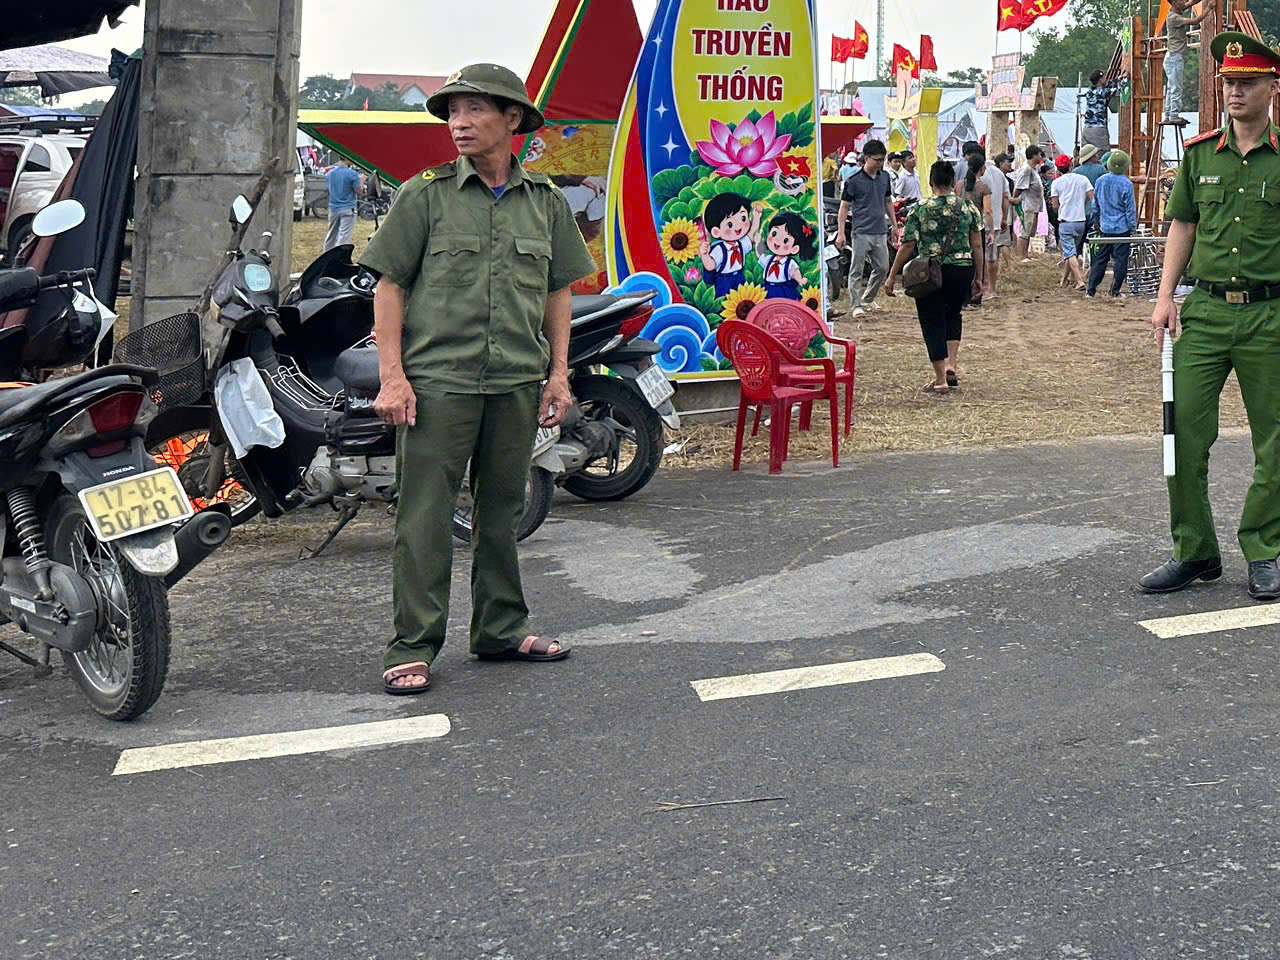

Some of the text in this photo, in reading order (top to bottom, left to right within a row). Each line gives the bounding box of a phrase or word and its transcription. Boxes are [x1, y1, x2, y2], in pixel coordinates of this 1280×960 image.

[692, 23, 791, 57] TRUYỀN
[697, 66, 783, 101] THỐNG
[102, 465, 137, 477] HONDA
[97, 476, 168, 511] 17-B4
[96, 494, 187, 536] 507.81
